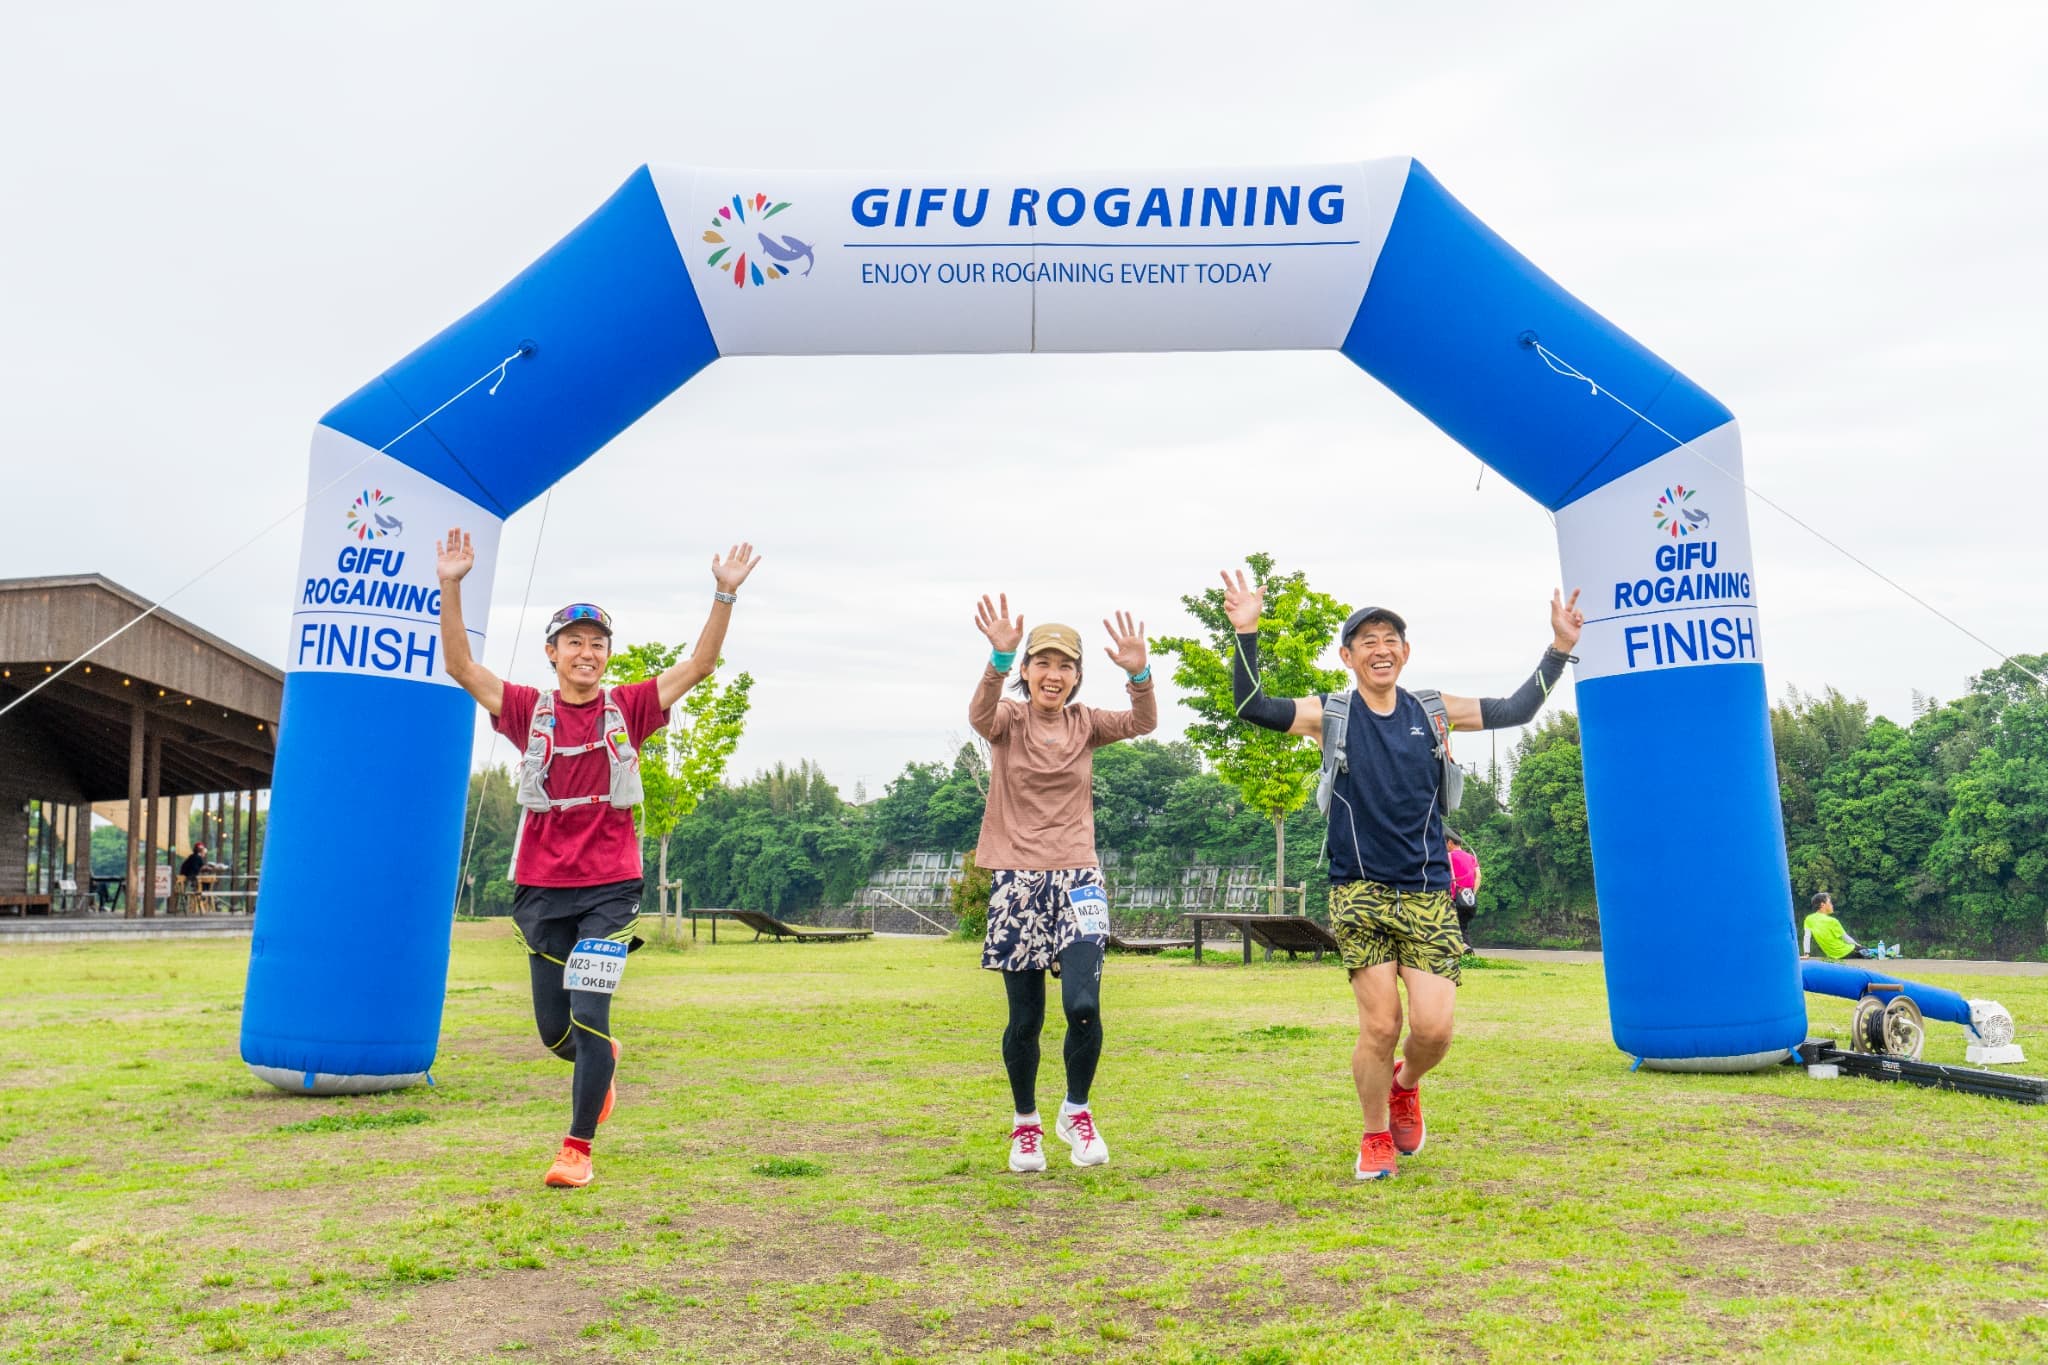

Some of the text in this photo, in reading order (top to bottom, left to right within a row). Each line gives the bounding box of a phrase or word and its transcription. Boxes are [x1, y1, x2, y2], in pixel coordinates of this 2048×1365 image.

[851, 184, 1345, 228] GIFU ROGAINING
[861, 262, 1272, 286] ENJOY OUR ROGAINING EVENT TODAY
[337, 546, 405, 577] GIFU
[1655, 541, 1717, 573] GIFU
[302, 577, 441, 616] ROGAINING
[1614, 572, 1750, 610] ROGAINING
[298, 623, 437, 677] FINISH
[1624, 617, 1756, 668] FINISH
